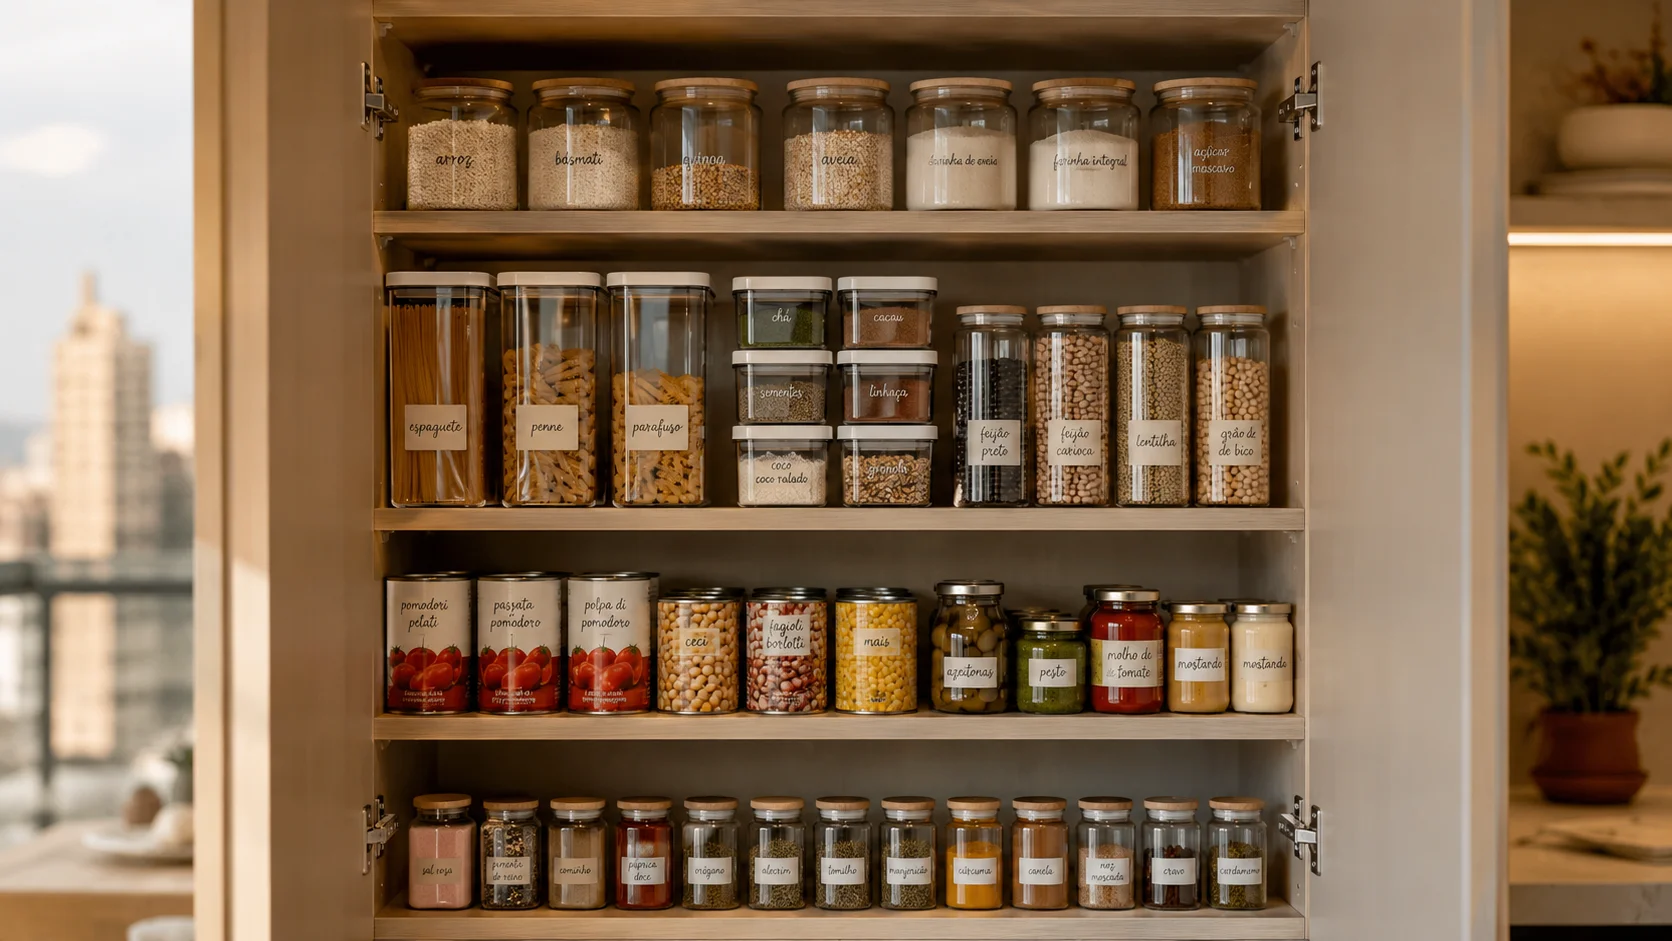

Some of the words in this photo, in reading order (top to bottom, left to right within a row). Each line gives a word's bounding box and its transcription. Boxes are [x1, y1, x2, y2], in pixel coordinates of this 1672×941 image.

[435, 154, 475, 168] arroz
[821, 155, 858, 165] aveia
[1092, 153, 1127, 170] integral
[771, 308, 792, 323] chá
[873, 314, 905, 322] cacau
[869, 383, 909, 402] linhaça
[409, 420, 463, 438] espaguete
[530, 423, 564, 438] penne
[632, 419, 683, 438] parafuso
[1135, 433, 1177, 447] lentilha
[981, 444, 1009, 461] preto
[1056, 445, 1095, 456] carioca
[1234, 443, 1254, 456] bico
[771, 462, 792, 471] coco
[755, 476, 775, 484] coco
[778, 472, 808, 484] ralado
[400, 597, 448, 615] pomodori
[493, 597, 535, 615] passata
[584, 596, 613, 615] polpa
[615, 597, 627, 610] di
[408, 615, 439, 632] pelati
[490, 614, 541, 632] pomodoro
[581, 614, 631, 632] pomodoro
[769, 620, 804, 638] fagioli
[685, 634, 709, 647] ceci
[766, 636, 806, 650] borlotti
[864, 636, 890, 648] mais
[1107, 646, 1138, 661] molho
[946, 664, 995, 680] azeitonas
[1039, 664, 1067, 681] pesto
[1117, 664, 1151, 679] tomate
[422, 864, 435, 876] sal
[436, 867, 453, 877] rosa
